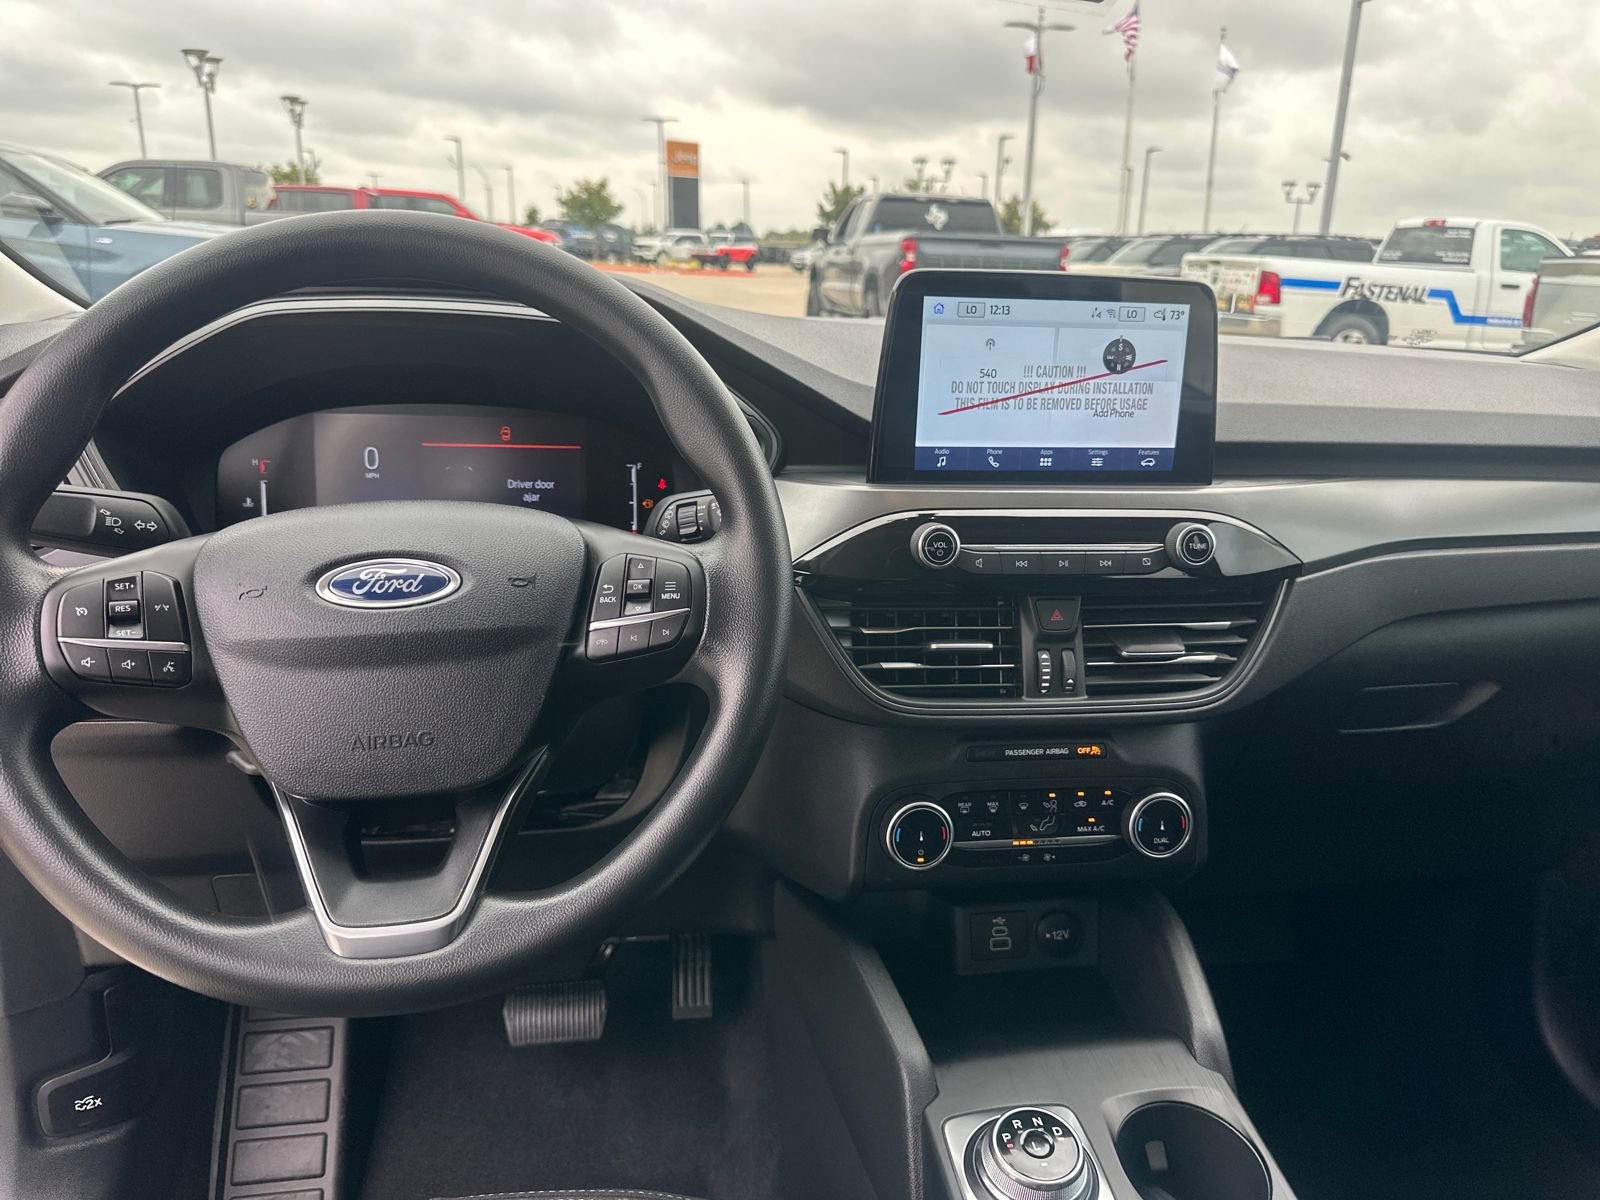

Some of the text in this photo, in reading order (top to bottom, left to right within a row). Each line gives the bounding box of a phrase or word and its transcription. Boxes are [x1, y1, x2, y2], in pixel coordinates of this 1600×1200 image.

[966, 306, 977, 314] LO
[990, 305, 1010, 316] 12:13
[1126, 310, 1138, 318] LO
[1170, 310, 1185, 320] 73°
[980, 368, 997, 378] 540
[1036, 365, 1074, 378] CAUTION
[951, 381, 1154, 395] DO NOT TOUCH DISPLAY DURING INSTALLATION
[955, 398, 1148, 410] THIS FILM IS TO BE REMOVED BEFORE USAGE
[1093, 408, 1135, 418] Add Phone
[364, 447, 379, 469] 0
[508, 479, 554, 489] Driver door
[523, 492, 540, 503] ajar
[352, 568, 425, 596] Ford
[351, 730, 434, 751] AIRBAG
[1052, 929, 1069, 940] 12V
[1012, 1119, 1023, 1129] R
[1032, 1116, 1044, 1127] N
[1052, 1126, 1063, 1136] D
[1002, 1132, 1012, 1143] P
[1032, 1141, 1040, 1151] L
